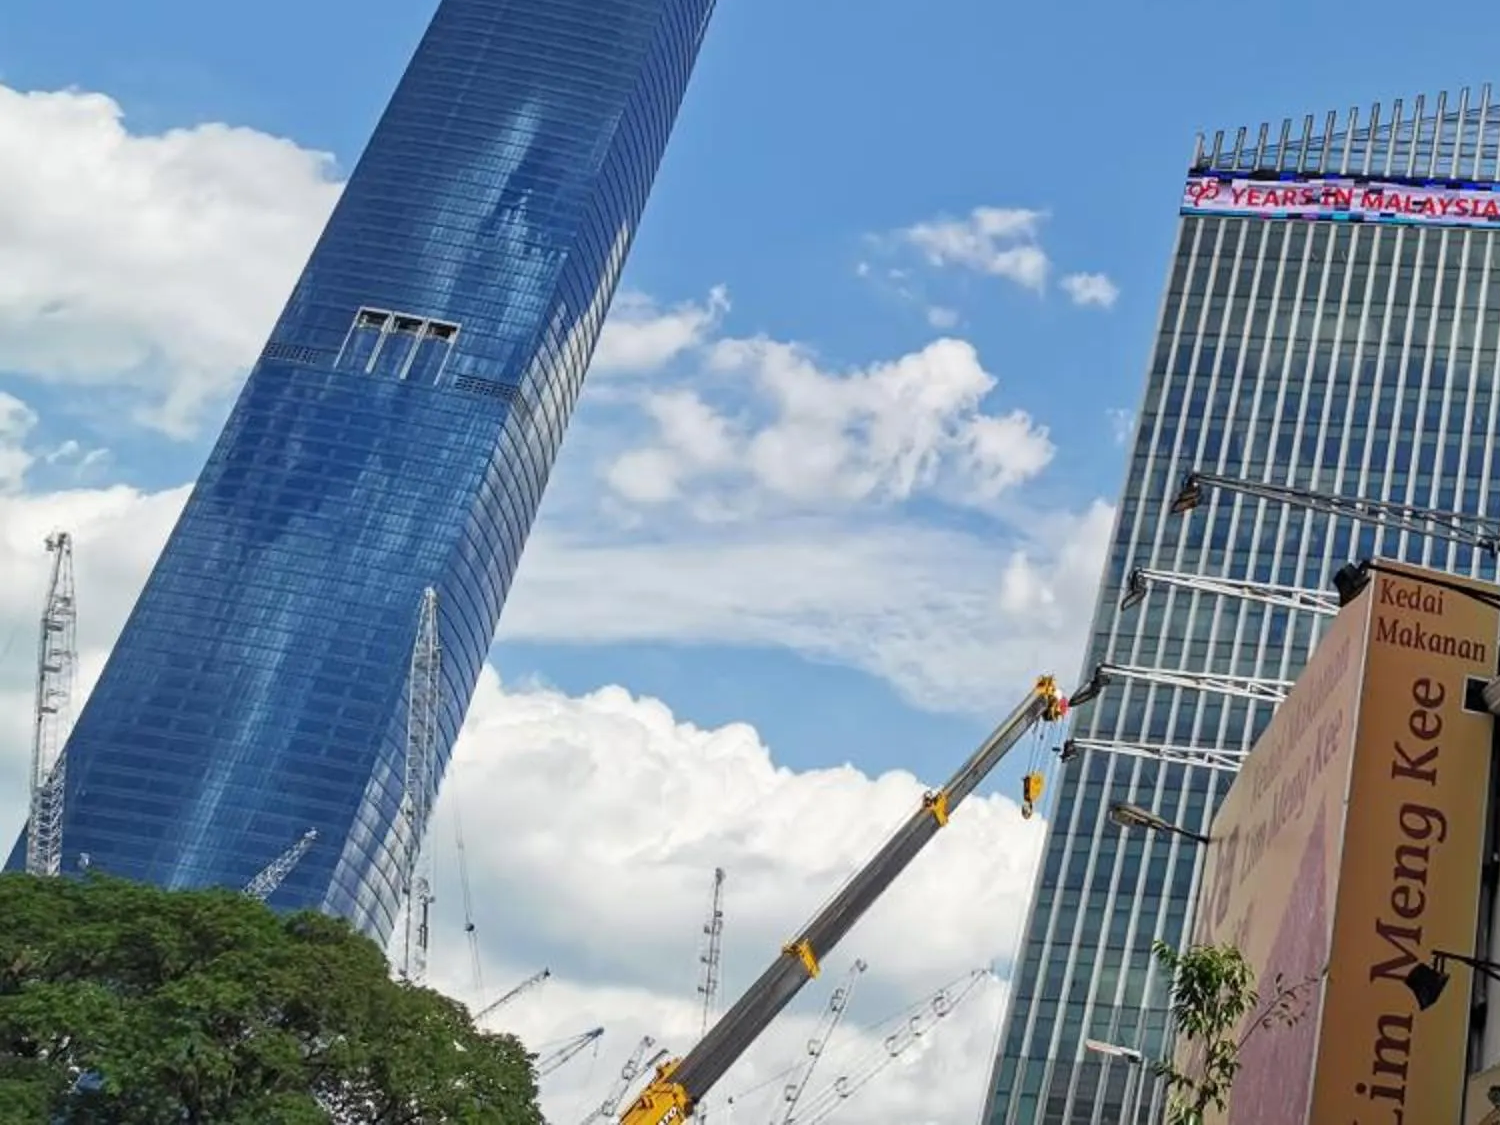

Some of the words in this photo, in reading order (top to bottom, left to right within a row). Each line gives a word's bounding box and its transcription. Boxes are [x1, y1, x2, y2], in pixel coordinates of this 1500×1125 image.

[1230, 186, 1314, 207] YEARS
[1321, 186, 1353, 208] IN
[1380, 578, 1444, 615] Kedai
[1376, 616, 1486, 663] Makanan
[1391, 677, 1446, 786] Kee
[1369, 803, 1448, 984] Meng
